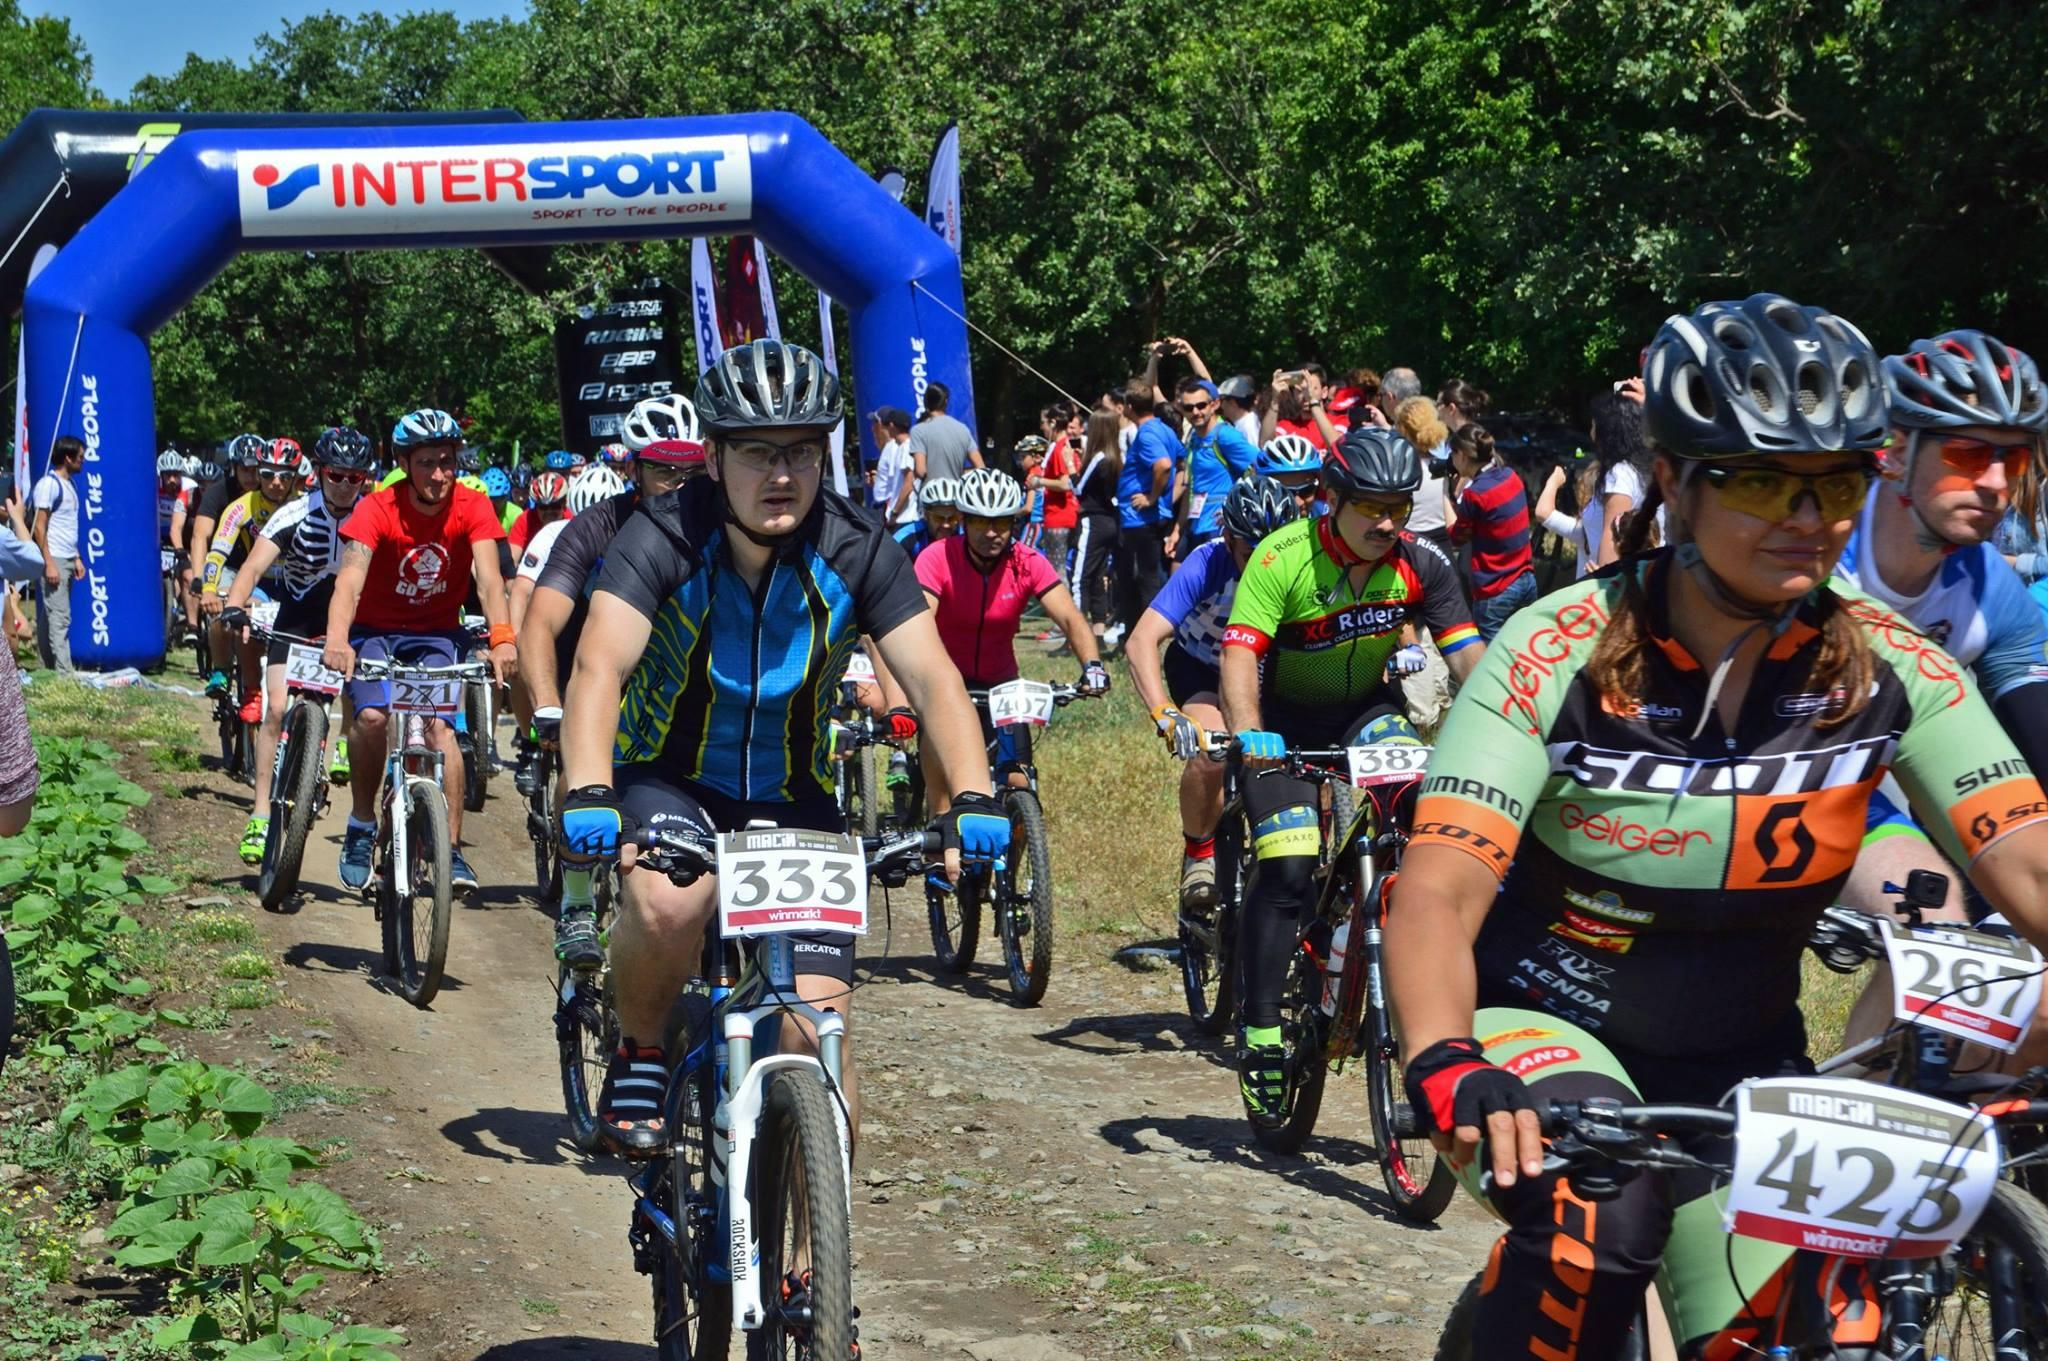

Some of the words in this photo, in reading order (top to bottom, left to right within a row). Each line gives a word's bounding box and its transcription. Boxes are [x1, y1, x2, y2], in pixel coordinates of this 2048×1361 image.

[332, 150, 724, 208] INTERSPORT
[531, 207, 587, 220] SPORT
[593, 206, 617, 218] TO
[624, 205, 657, 217] THE
[666, 202, 728, 215] PEOPLE
[82, 374, 100, 463] PEOPLE
[85, 473, 103, 521] THE
[89, 530, 105, 564] TO
[1260, 551, 1277, 569] XC
[1273, 532, 1310, 553] Riders
[1416, 538, 1452, 567] Riders
[89, 569, 109, 647] SPORT
[1304, 621, 1334, 640] XC
[1339, 606, 1405, 631] Riders
[395, 682, 452, 704] 271
[996, 696, 1048, 717] 407
[1358, 747, 1430, 774] 382
[1551, 739, 1890, 797] SCOTT
[731, 858, 857, 907] 333
[768, 909, 822, 921] winmarkt
[1518, 958, 1612, 1014] KENDA
[1901, 948, 2029, 1018] 267
[1754, 1126, 1968, 1235] 423
[1802, 1229, 1889, 1256] winmarkt
